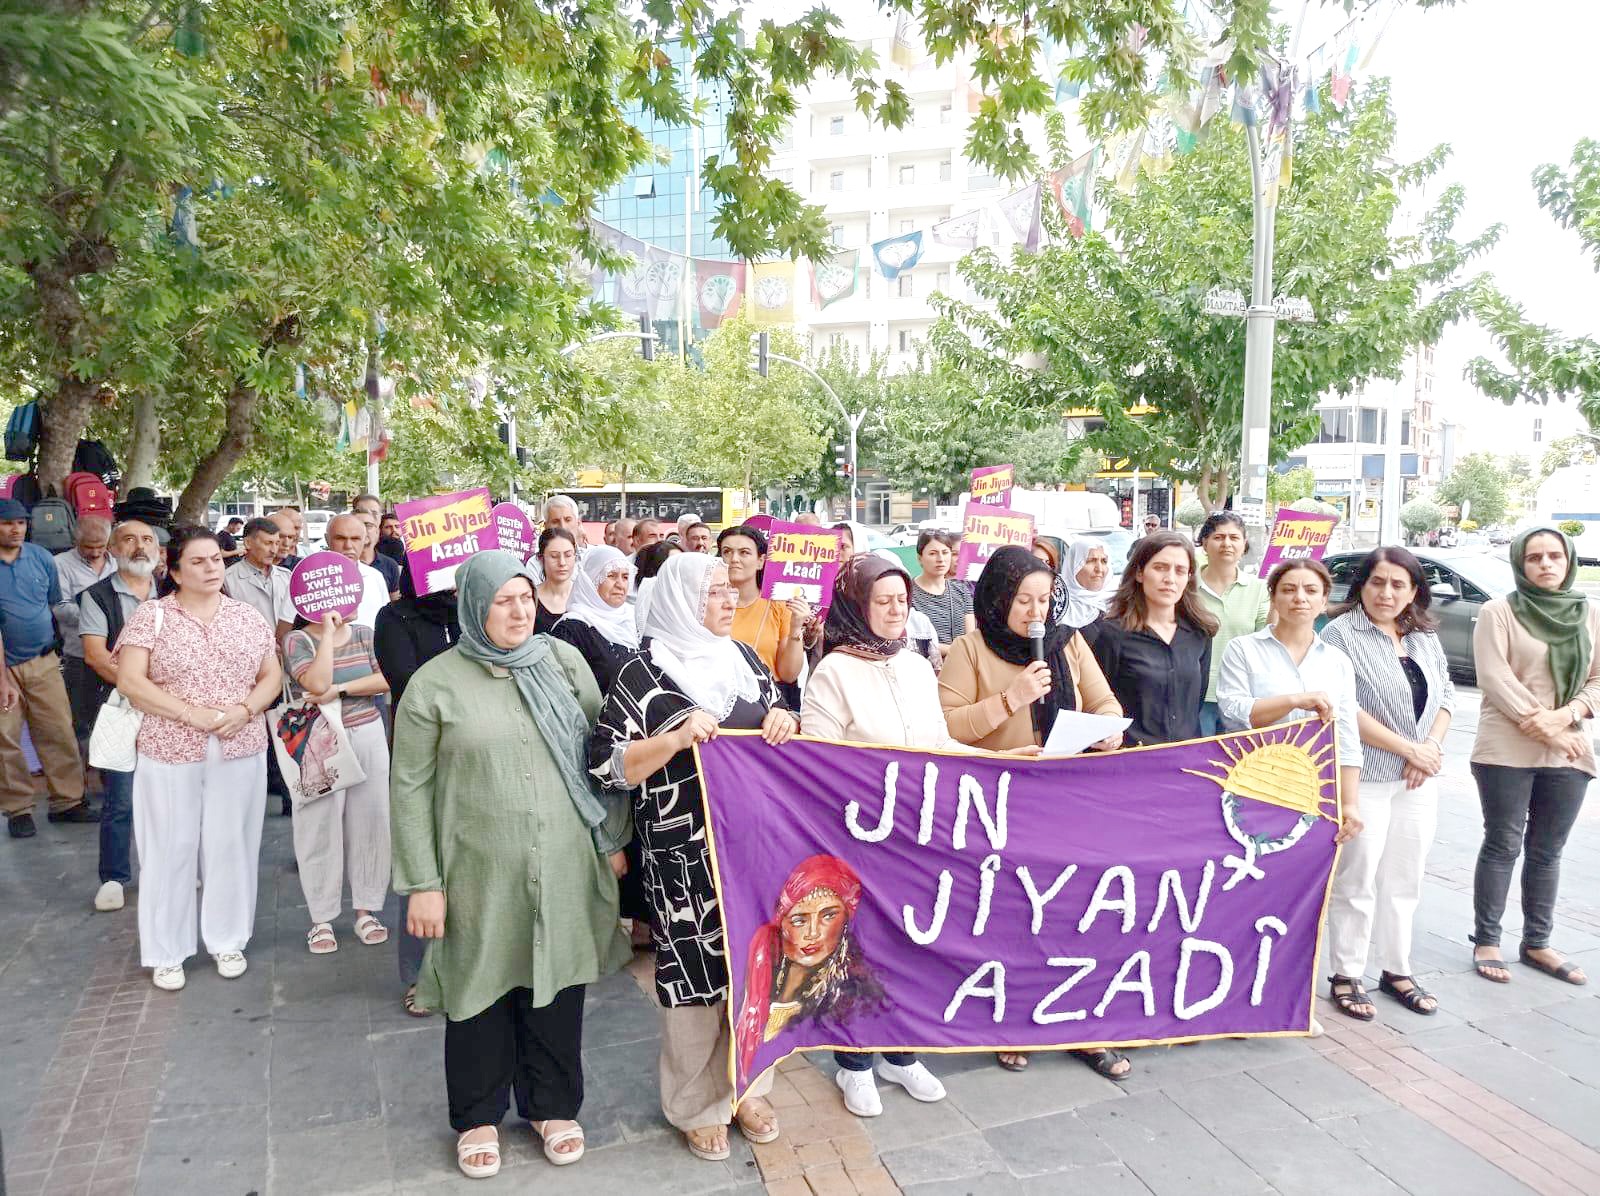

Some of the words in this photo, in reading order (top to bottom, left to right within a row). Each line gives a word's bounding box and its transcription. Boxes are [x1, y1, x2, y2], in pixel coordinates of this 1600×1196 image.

[974, 480, 987, 491] Jin
[408, 519, 437, 539] Jin
[442, 511, 488, 534] Jîyan
[497, 515, 523, 530] DESTÊN
[498, 526, 515, 538] XWE
[967, 517, 989, 535] Jin
[994, 522, 1028, 544] Jîyan
[1277, 523, 1295, 538] Jin
[1297, 525, 1328, 545] Jîyan
[431, 535, 480, 563] Azadî
[520, 541, 531, 552] ME
[774, 536, 795, 554] Jin
[800, 540, 835, 562] Jîyan
[1280, 544, 1314, 559] Azadî
[302, 564, 343, 582] DESTÊN
[783, 560, 823, 580] Azadî
[306, 578, 331, 591] XWE
[334, 575, 343, 585] JI
[294, 586, 344, 606] BEDENÊN
[345, 583, 361, 593] ME
[303, 594, 356, 614] VEKIŞÎNIN
[845, 761, 1010, 851] JIN
[903, 854, 1214, 946] JÎYAN
[944, 916, 1287, 1025] AZADÎ
